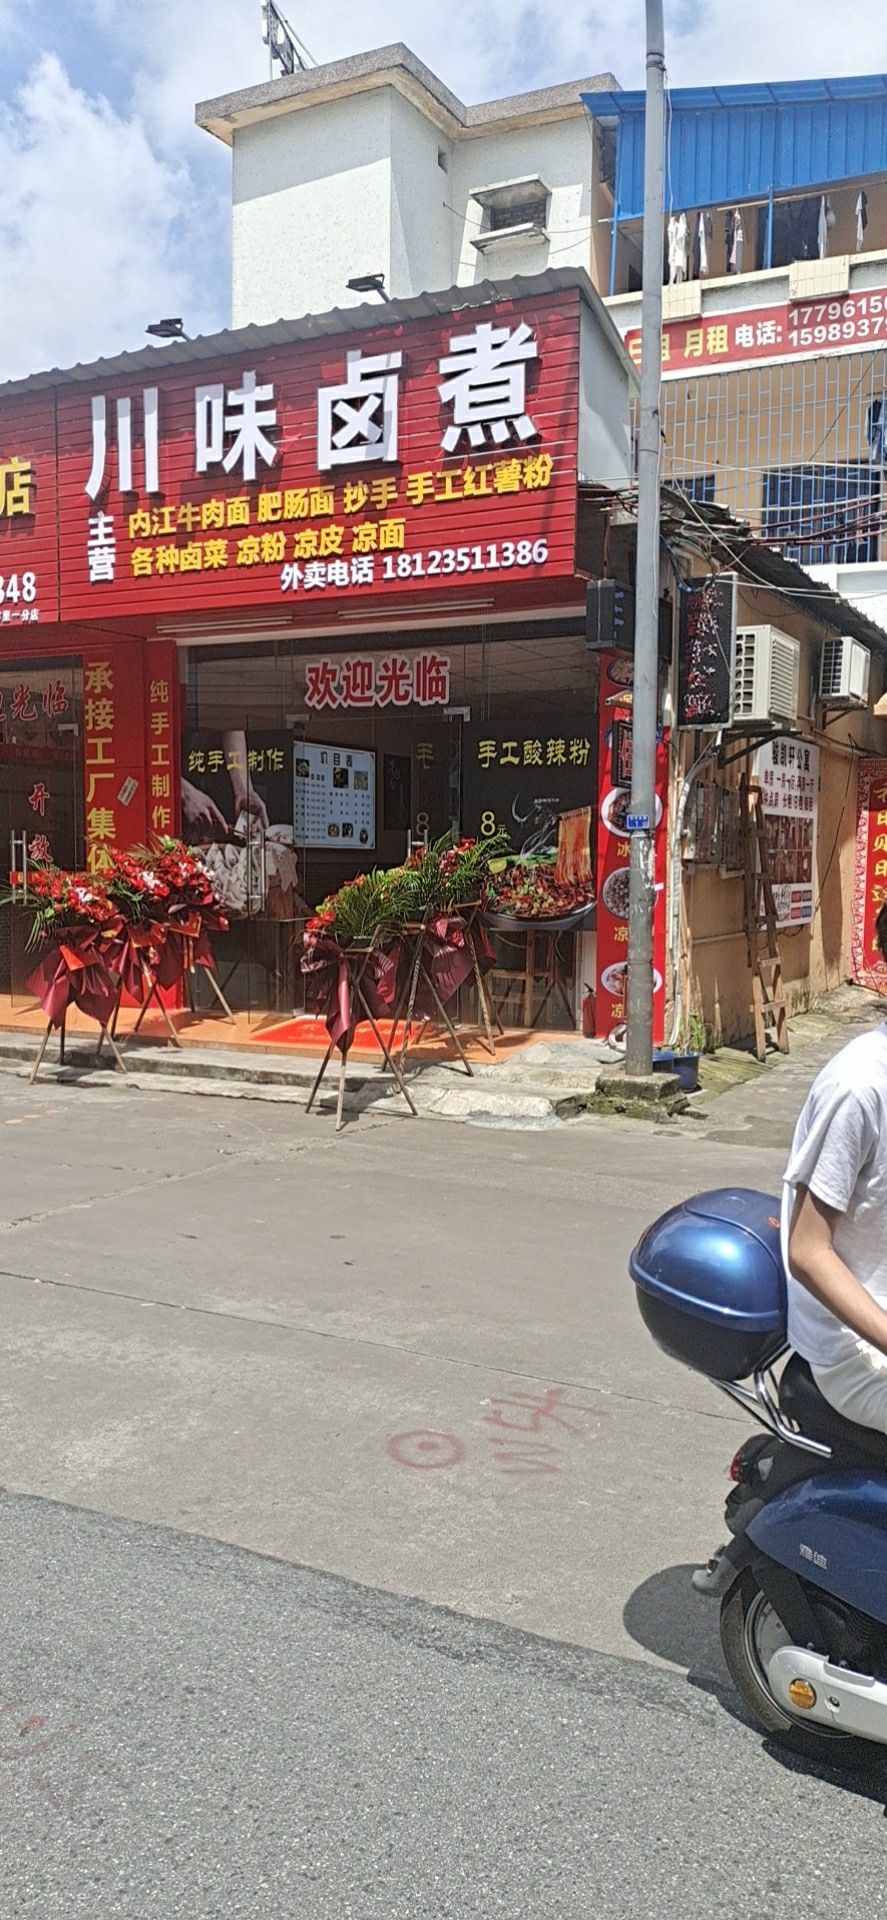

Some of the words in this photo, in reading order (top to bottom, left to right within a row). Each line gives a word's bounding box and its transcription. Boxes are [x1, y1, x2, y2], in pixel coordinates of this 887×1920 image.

[788, 316, 887, 347] 1598937
[789, 295, 887, 326] 1779615
[684, 324, 728, 359] 月租
[85, 322, 539, 499] 川味卤煮
[0, 456, 31, 516] 店
[128, 496, 249, 538] 内江牛肉面
[257, 483, 334, 522] 肥肠面
[344, 477, 398, 512] 抄手
[406, 453, 553, 505] 手工红薯粉
[87, 511, 116, 582] 主营
[131, 539, 228, 577] 各种卤菜
[236, 531, 286, 565] 凉粉
[293, 523, 344, 560] 凉皮
[351, 517, 406, 553] 凉面
[280, 556, 374, 591] 外卖电话
[383, 539, 548, 580] 18123511386
[0, 680, 69, 722] 光临
[306, 654, 448, 708] 欢迎光临
[85, 661, 116, 875] 承接工厂集体
[150, 680, 171, 829] 纯手工制作
[188, 747, 284, 773] 纯手工制作
[478, 738, 590, 768] 手工酸辣粉
[28, 783, 53, 863] 开放
[617, 842, 630, 857] 冰
[614, 926, 629, 941] 凉
[611, 1003, 625, 1018] 凉
